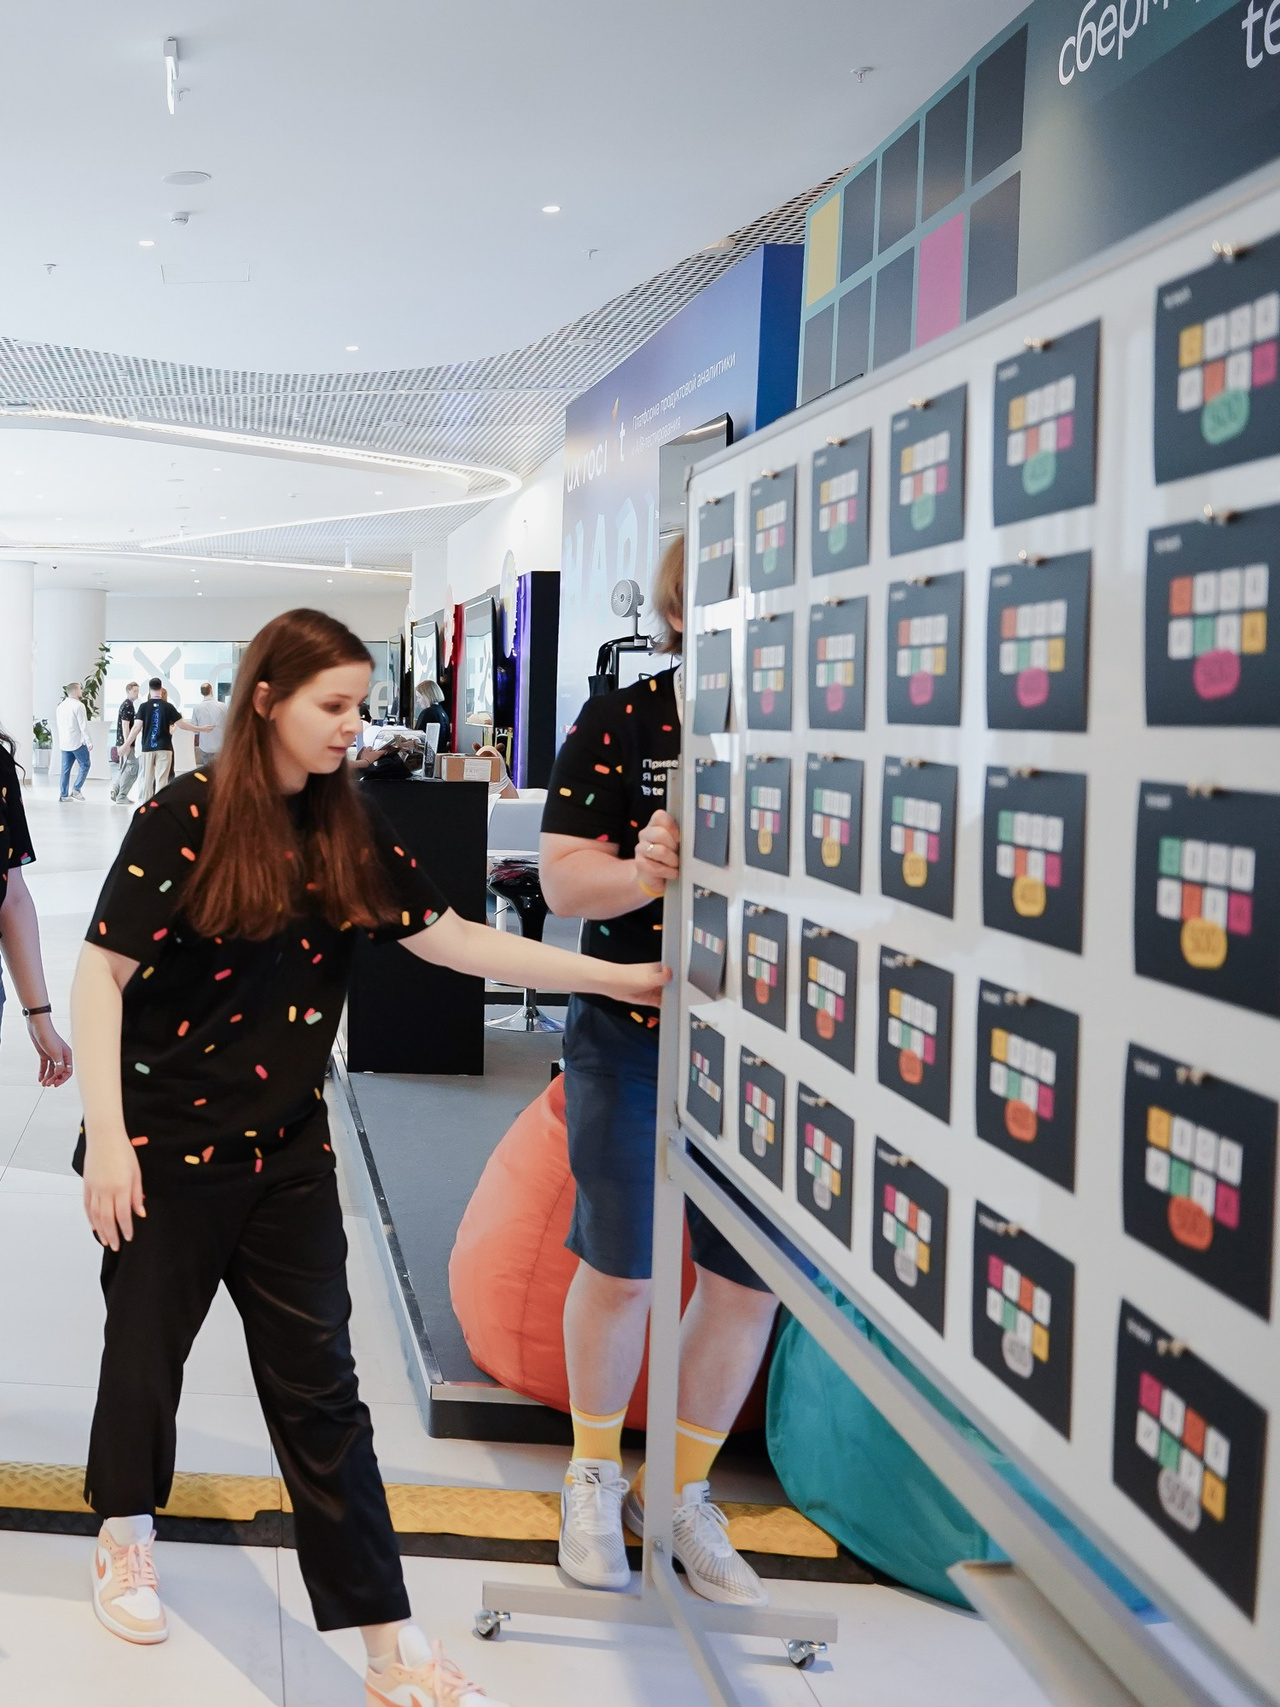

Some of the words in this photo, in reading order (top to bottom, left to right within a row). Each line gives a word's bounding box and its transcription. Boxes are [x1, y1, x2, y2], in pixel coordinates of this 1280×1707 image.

[697, 352, 736, 389] аналитики
[642, 758, 679, 770] Приве
[642, 772, 652, 782] Я
[653, 773, 667, 782] из
[652, 786, 665, 797] te
